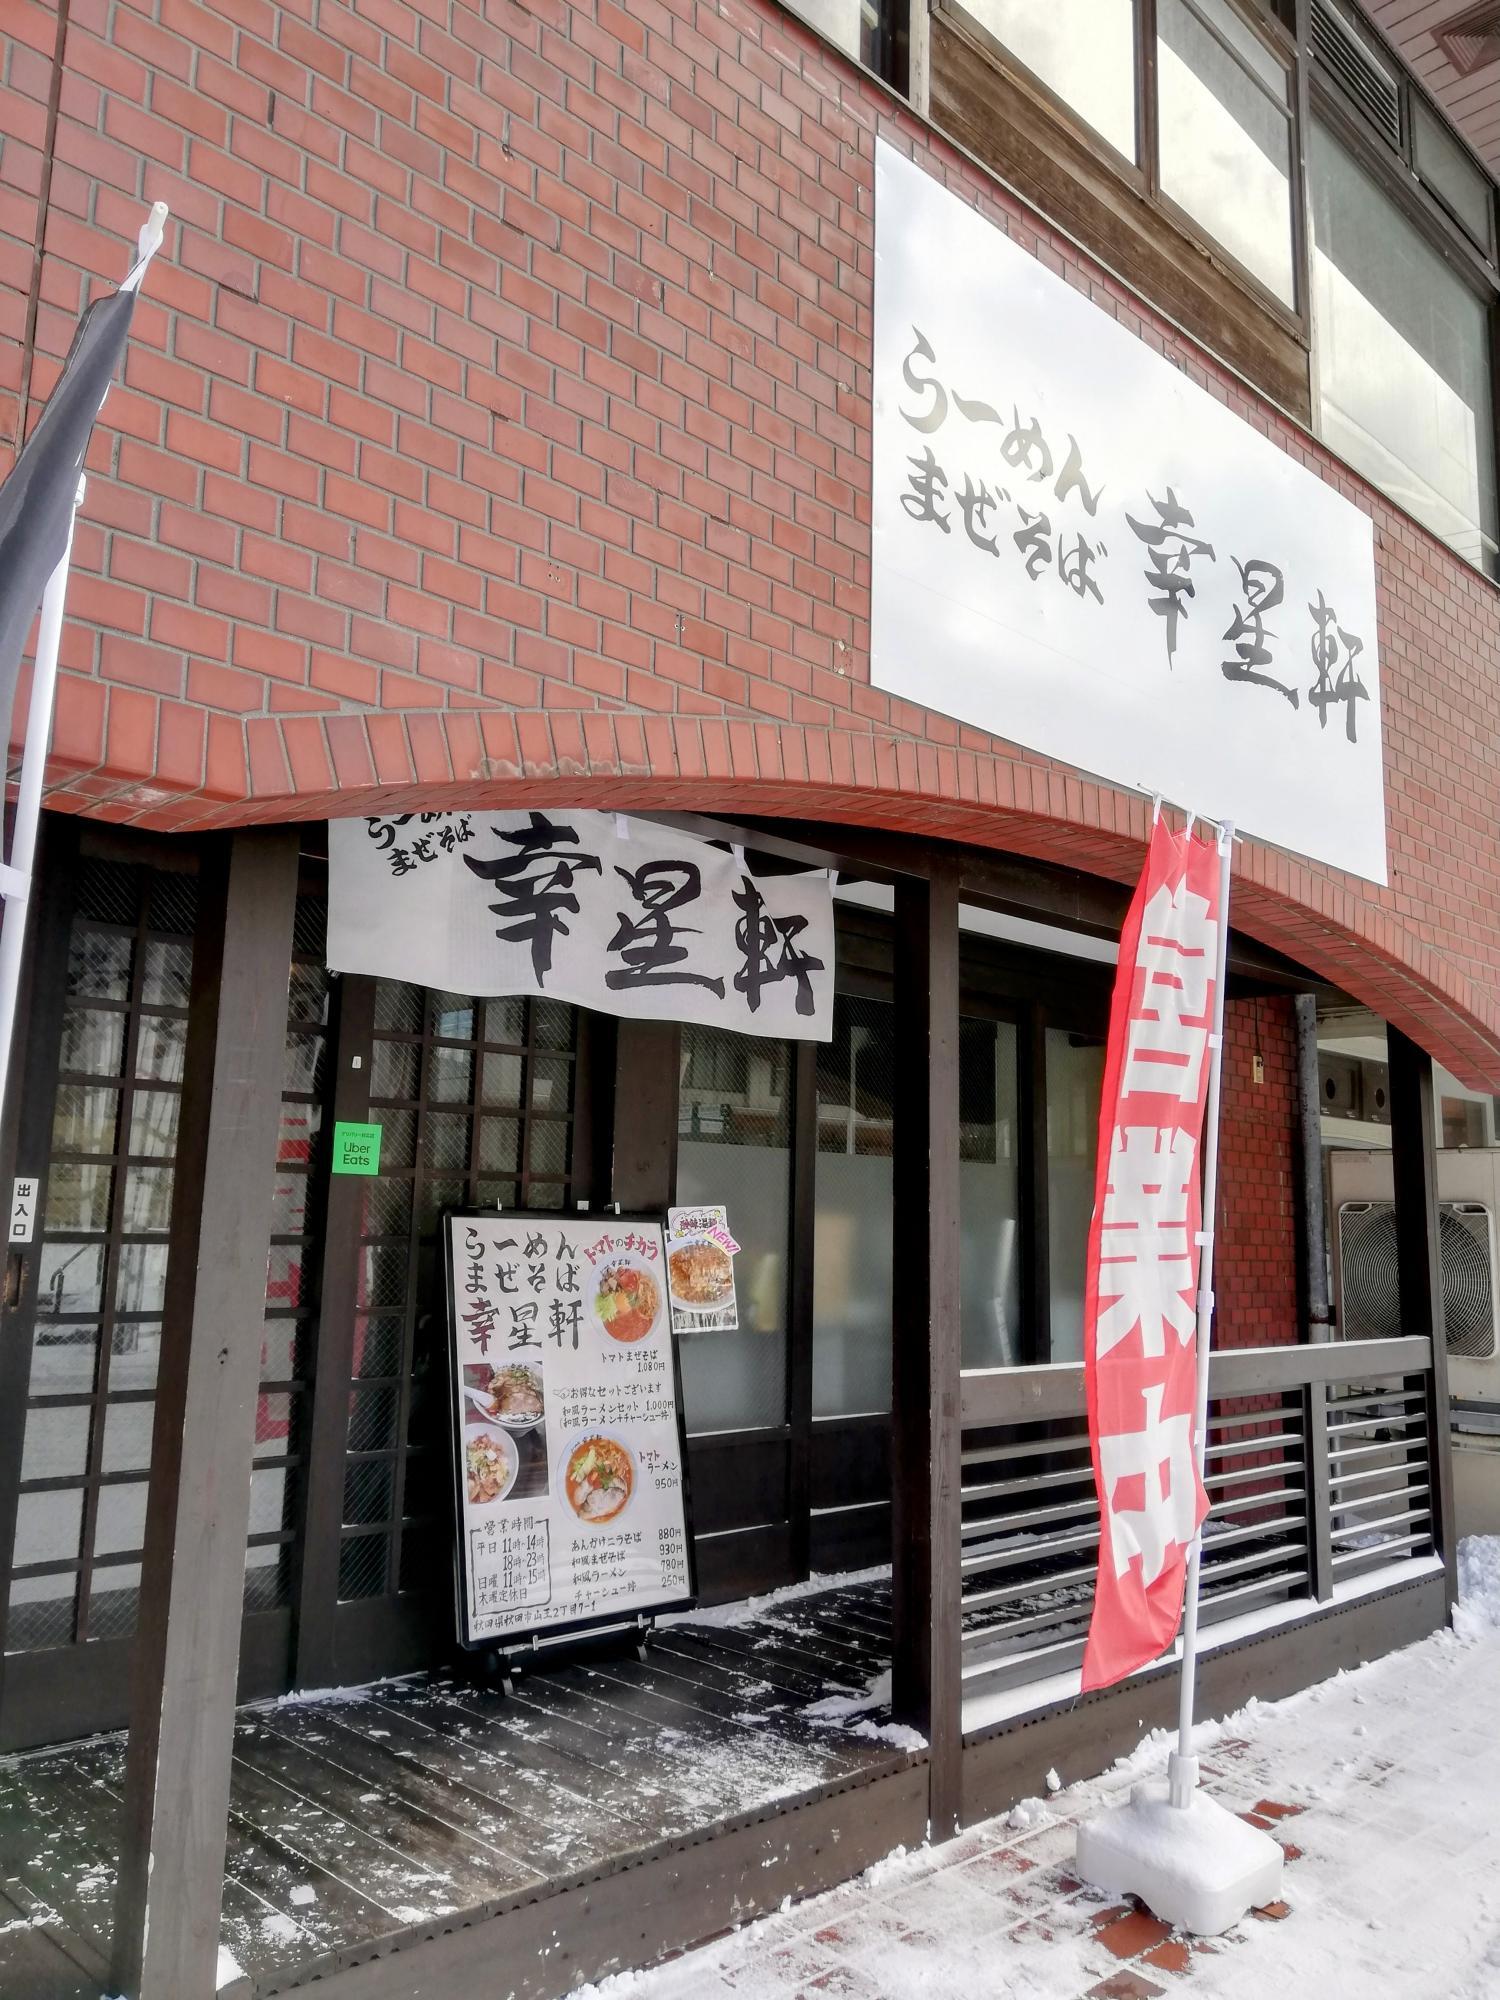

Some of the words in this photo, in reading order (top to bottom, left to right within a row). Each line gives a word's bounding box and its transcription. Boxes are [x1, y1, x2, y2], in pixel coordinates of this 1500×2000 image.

[899, 325, 1106, 517] らーめん
[899, 445, 1108, 605] まぜそば
[386, 814, 476, 876] まぜそば
[344, 1142, 371, 1154] Uber
[343, 1154, 370, 1166] Eats
[12, 1183, 32, 1237] 出入口
[464, 1226, 578, 1261] らーめん
[707, 1226, 739, 1253] NEW!
[584, 1232, 659, 1265] トマトのチカラ
[465, 1261, 580, 1294] まぜそば
[601, 1350, 658, 1363] トマトまぜそば
[570, 1381, 662, 1399] お得なセットございます
[562, 1402, 639, 1417] 和風ラーメンセット
[639, 1450, 660, 1463] トマト
[647, 1460, 679, 1474] ラーメン
[655, 1477, 679, 1490] 950円
[571, 1531, 642, 1552] あんかけニラそば
[658, 1527, 682, 1540] 880円
[477, 1541, 497, 1556] 平日
[660, 1543, 683, 1555] 930円
[571, 1550, 627, 1568] 和風まぜそば
[660, 1558, 684, 1572] 780円
[478, 1573, 499, 1590] 日曜
[572, 1567, 627, 1585] 和風ラーメン
[661, 1574, 685, 1588] 250円
[479, 1588, 528, 1606] 木曜定休日
